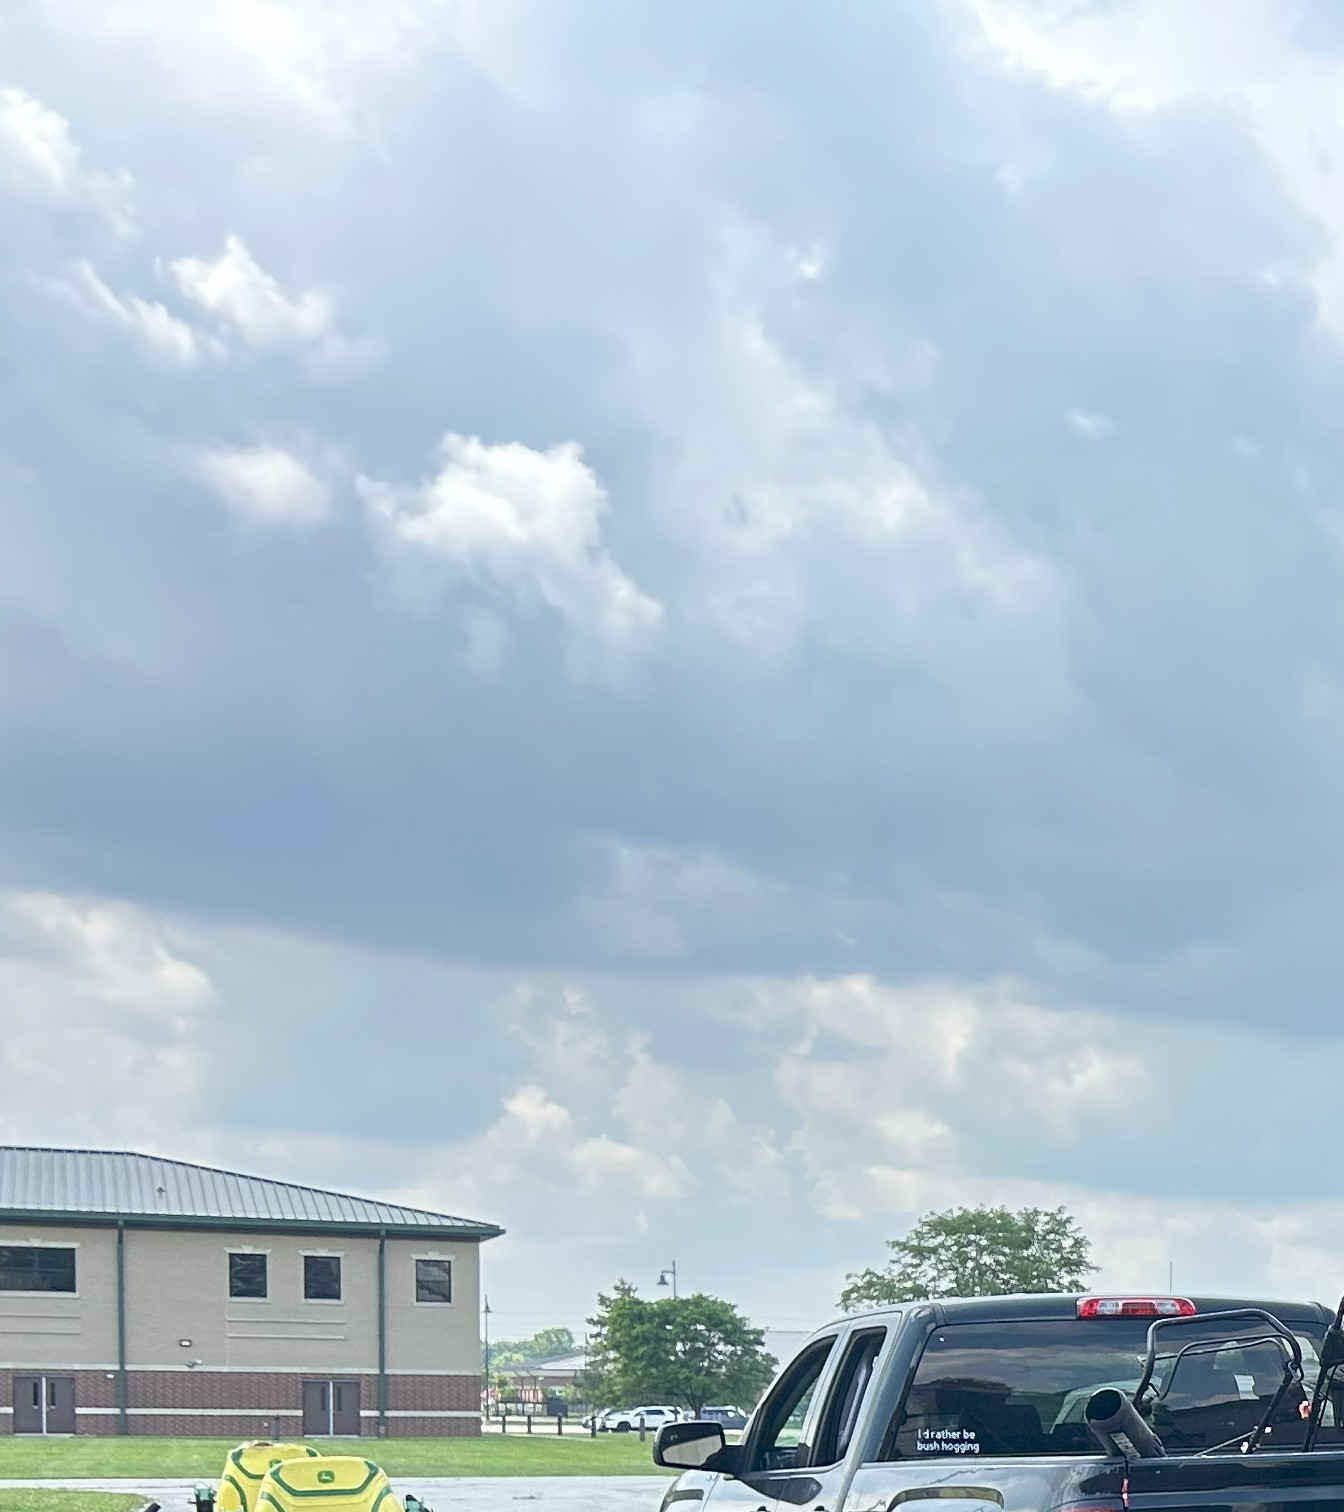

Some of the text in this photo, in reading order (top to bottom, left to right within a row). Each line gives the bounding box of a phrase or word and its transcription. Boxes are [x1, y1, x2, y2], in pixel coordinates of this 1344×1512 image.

[930, 1428, 961, 1440] rather
[962, 1428, 976, 1440] be
[916, 1440, 980, 1454] bush hogging
